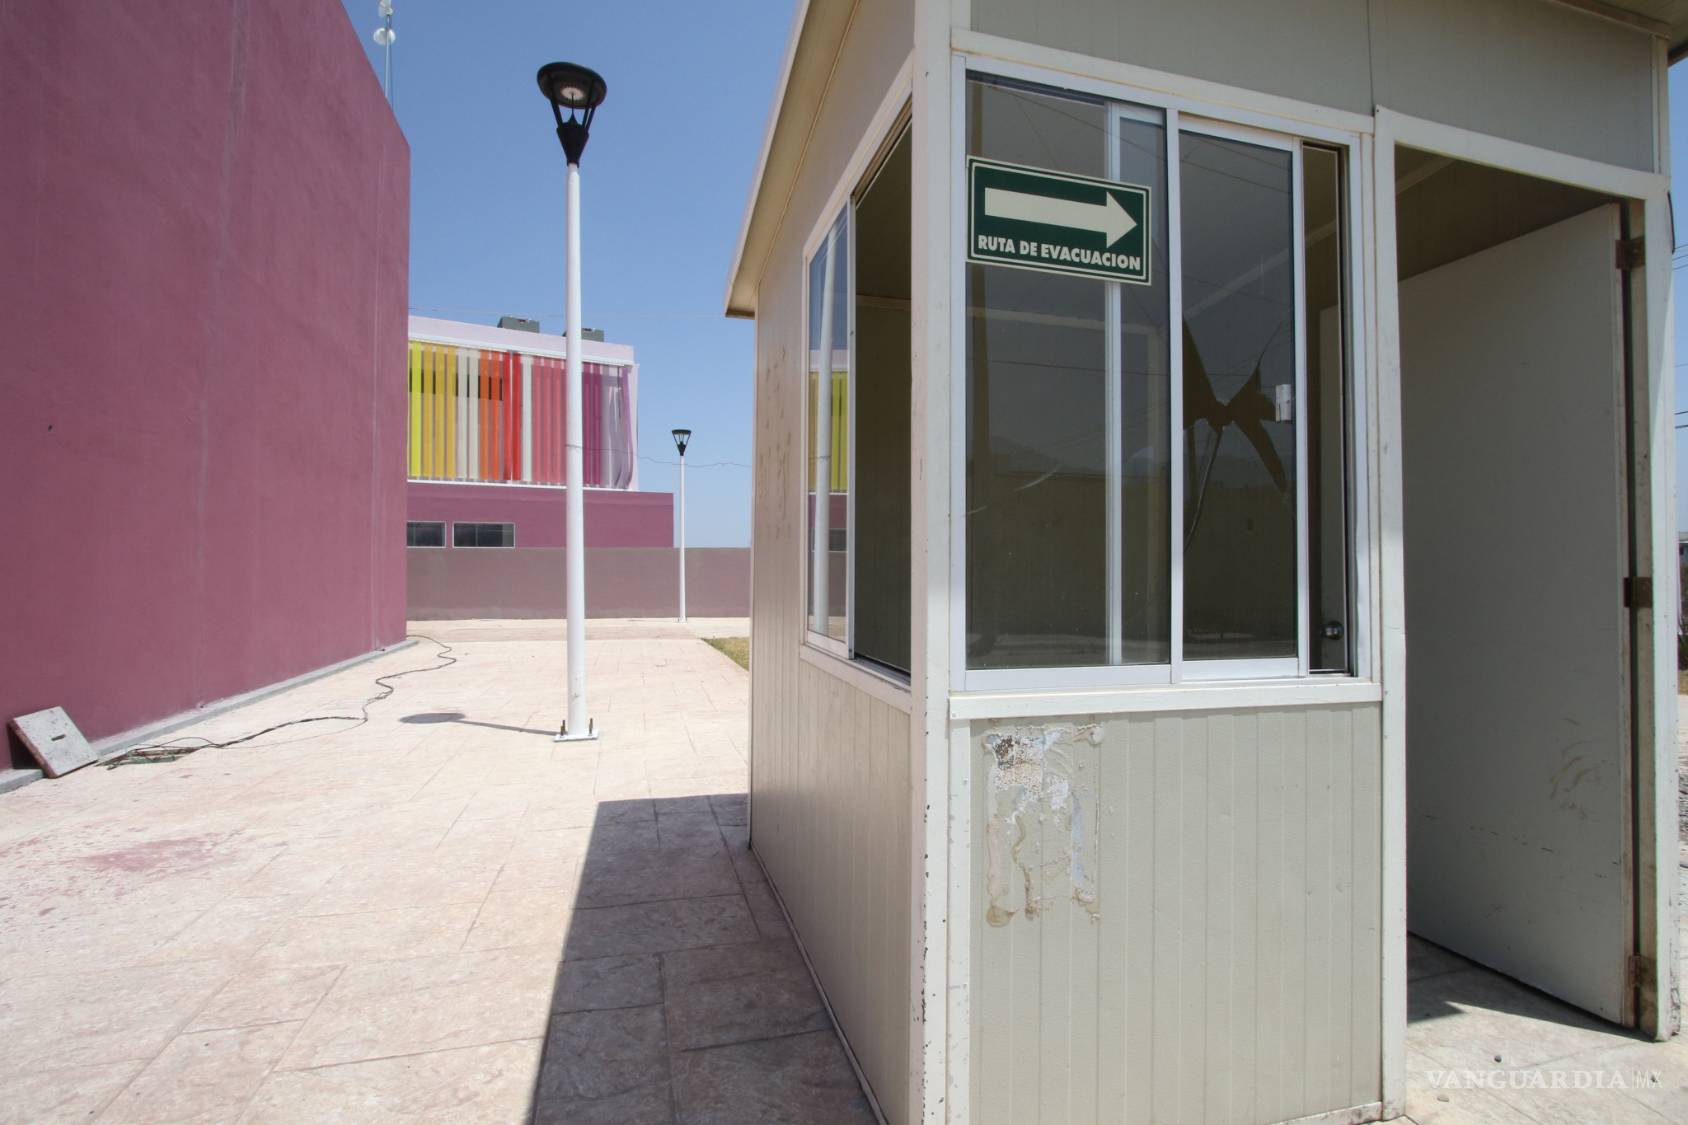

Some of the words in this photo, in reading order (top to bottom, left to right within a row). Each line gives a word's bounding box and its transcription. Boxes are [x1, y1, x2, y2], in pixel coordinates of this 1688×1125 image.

[978, 235, 1015, 254] RUTA
[1019, 240, 1038, 256] DE
[1040, 244, 1141, 270] EVACUACION
